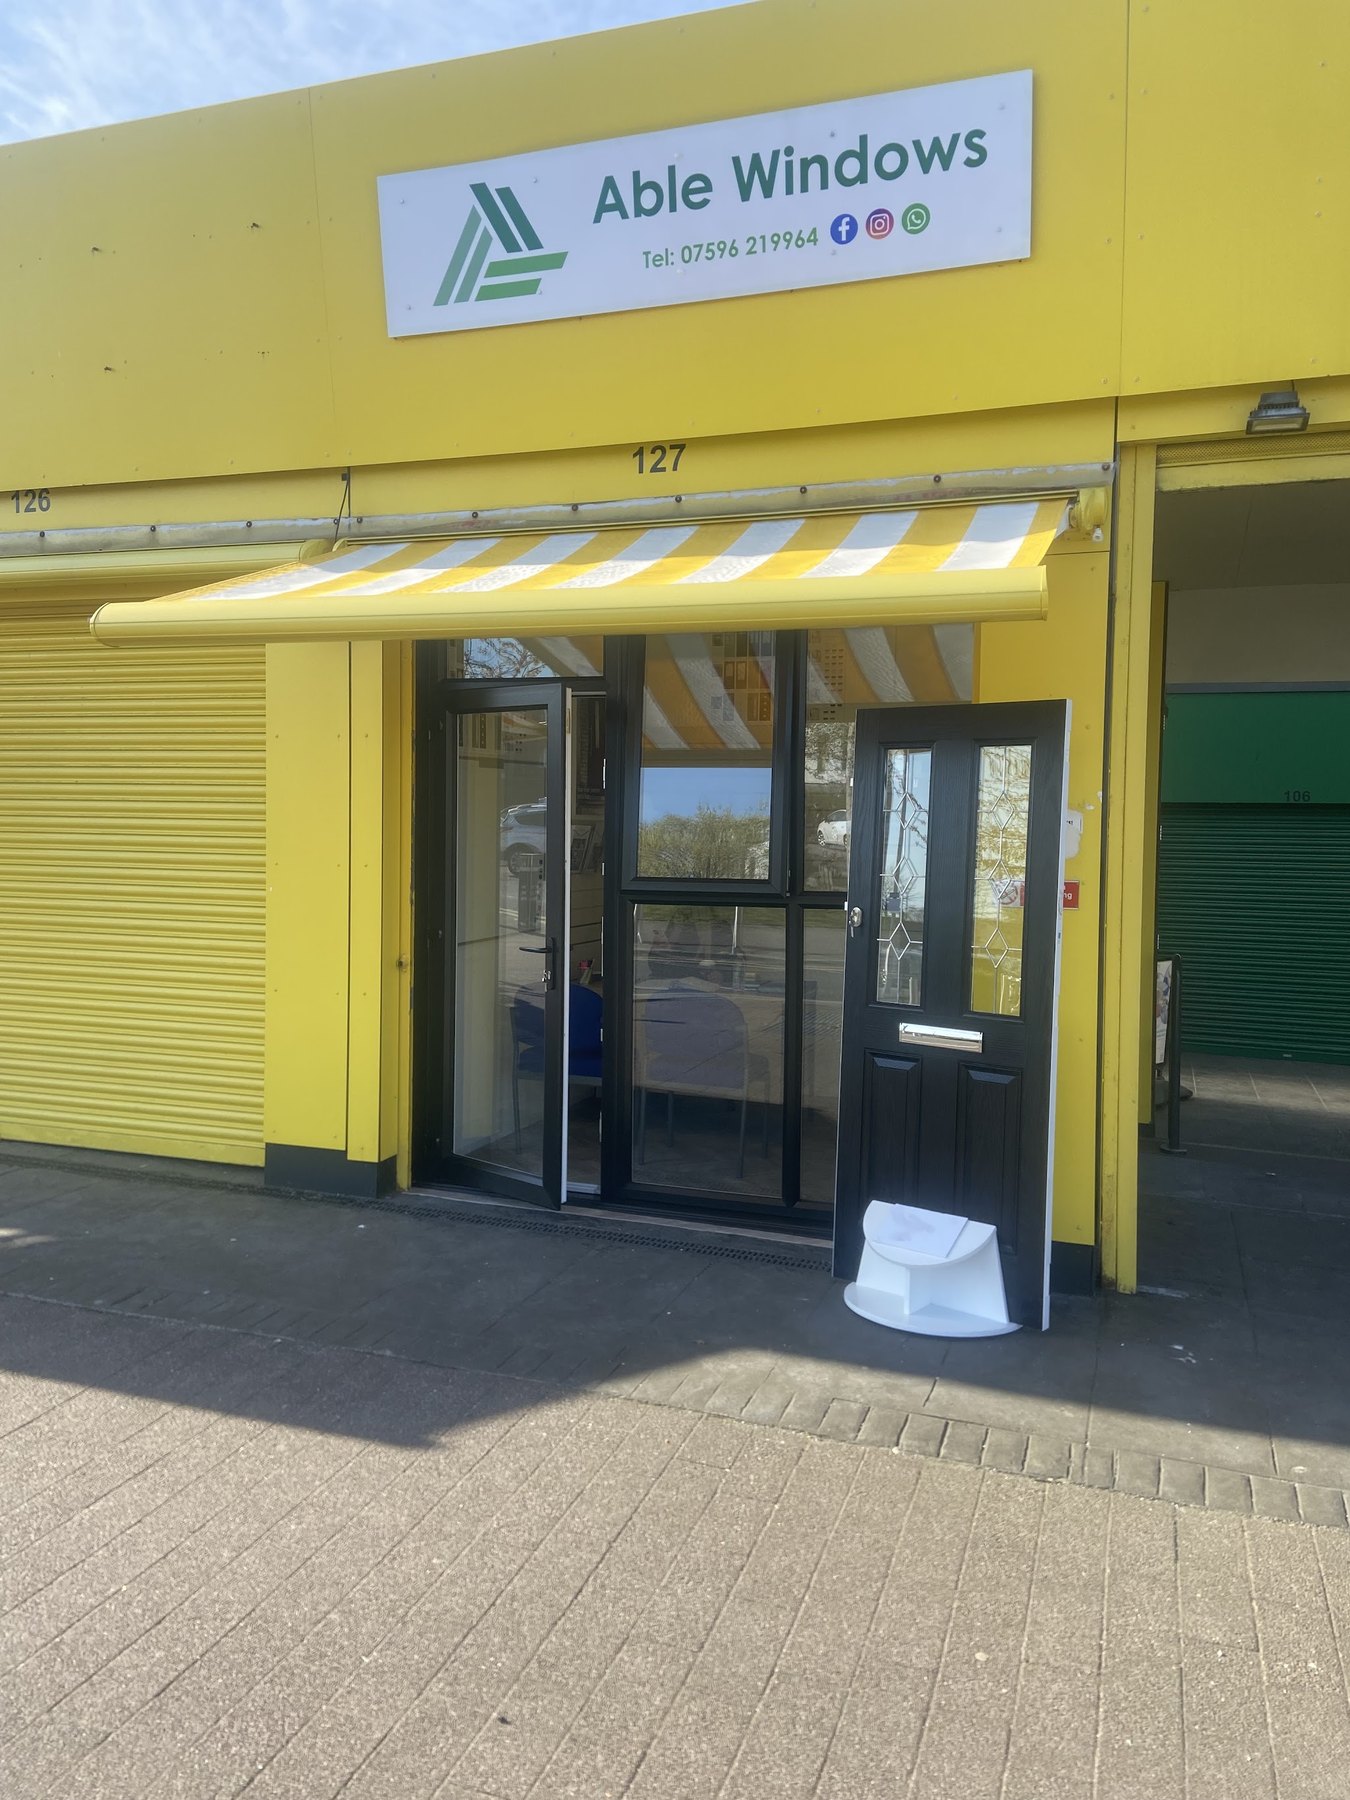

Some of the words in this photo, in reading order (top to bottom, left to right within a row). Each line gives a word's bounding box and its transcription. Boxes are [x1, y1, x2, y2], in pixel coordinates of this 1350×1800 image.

[592, 164, 714, 225] Able
[731, 128, 989, 203] Windows
[642, 247, 675, 269] Tel:
[680, 238, 739, 264] 07596
[745, 227, 819, 256] 219964
[632, 443, 687, 475] 127
[10, 488, 51, 514] 126
[1283, 790, 1311, 802] 106
